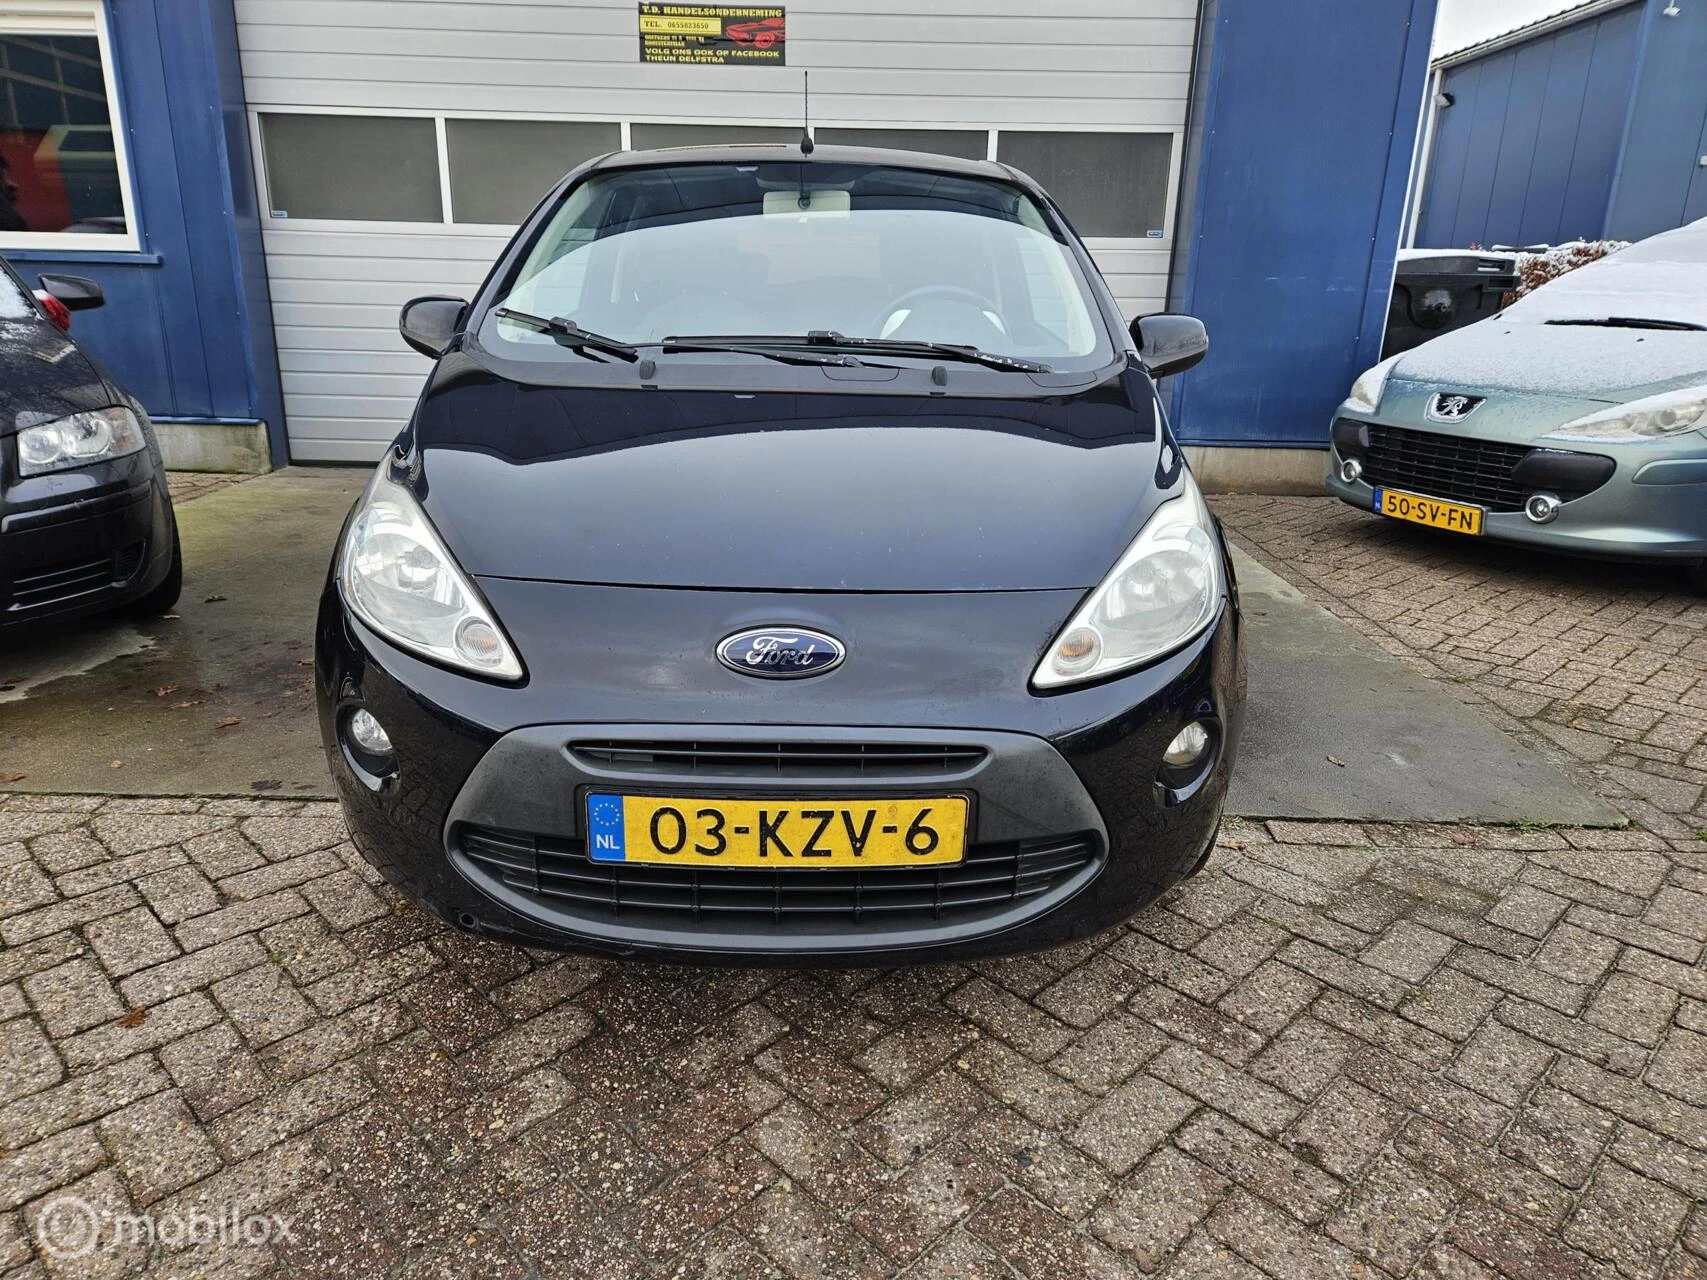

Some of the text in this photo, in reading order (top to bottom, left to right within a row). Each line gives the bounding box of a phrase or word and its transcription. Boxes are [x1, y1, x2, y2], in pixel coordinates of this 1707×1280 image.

[641, 5, 782, 17] T.D. HANDELSONDERNEMING
[644, 20, 662, 28] TEL.
[672, 48, 692, 56] ONS
[716, 49, 730, 57] OP
[679, 55, 724, 63] DELFSTRA
[1387, 495, 1473, 530] 50-SV-FN
[745, 636, 816, 666] Ford
[650, 806, 940, 858] 03-KZV-6
[595, 834, 621, 850] NL
